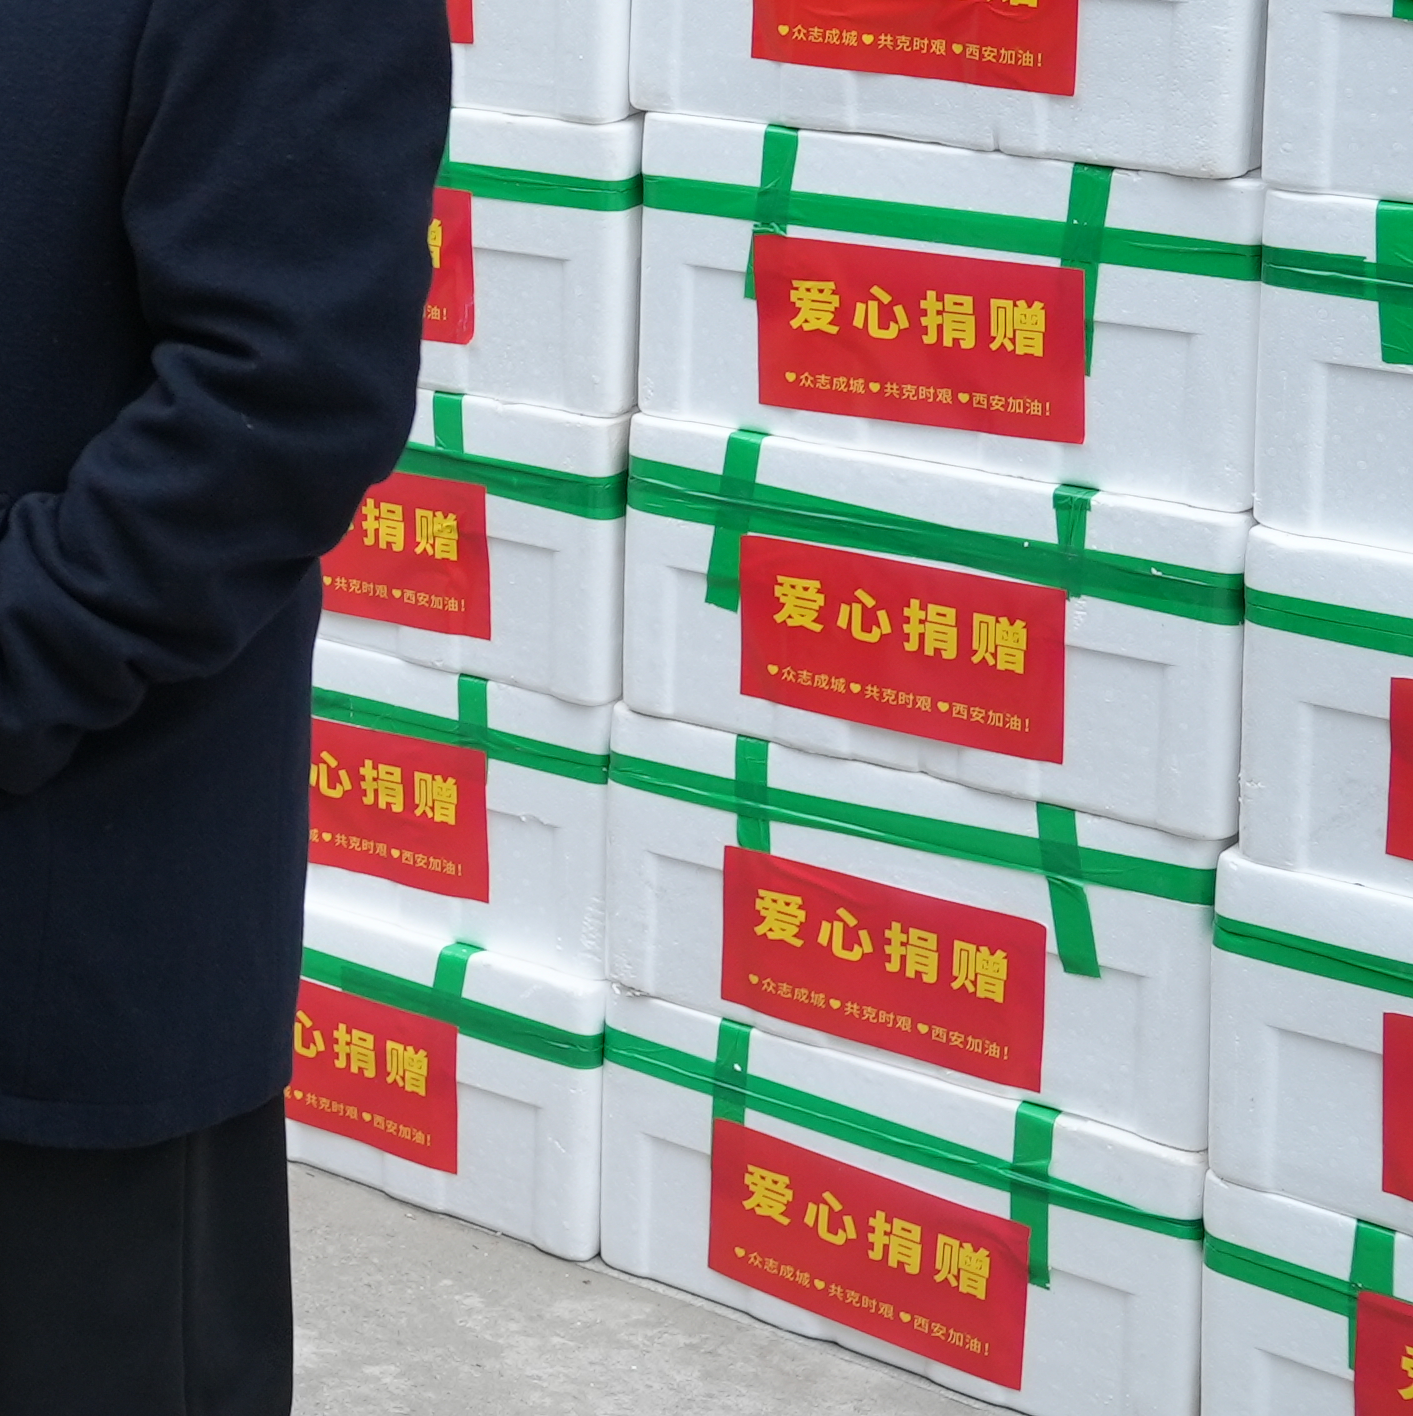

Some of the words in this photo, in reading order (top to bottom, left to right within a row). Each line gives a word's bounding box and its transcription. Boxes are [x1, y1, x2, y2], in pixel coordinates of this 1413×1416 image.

[791, 23, 859, 48] 众志成城
[876, 31, 948, 56] 共克时艰
[964, 41, 1044, 69] 西安加油!
[787, 278, 1048, 358] 爱心捐赠
[798, 370, 866, 396] 众志成城
[883, 380, 954, 405] 共克时艰
[972, 390, 1051, 417] 西安加油!
[334, 576, 389, 600] 共克时艰
[772, 572, 1029, 675] 爱心捐赠
[780, 664, 847, 695] 众志成城
[863, 682, 933, 714] 共克时艰
[951, 700, 1031, 734] 西安加油!
[334, 831, 388, 858] 共克时艰
[753, 887, 1010, 1004] 爱心捐赠
[761, 975, 826, 1011] 众志成城
[844, 997, 913, 1034] 共克时艰
[930, 1022, 1010, 1062] 西安加油!
[305, 1091, 359, 1122] 共克时艰
[741, 1162, 992, 1301] 爱心捐赠
[747, 1249, 811, 1289] 众志成城
[827, 1280, 895, 1322] 共克时艰
[912, 1314, 991, 1357] 西安加油!
